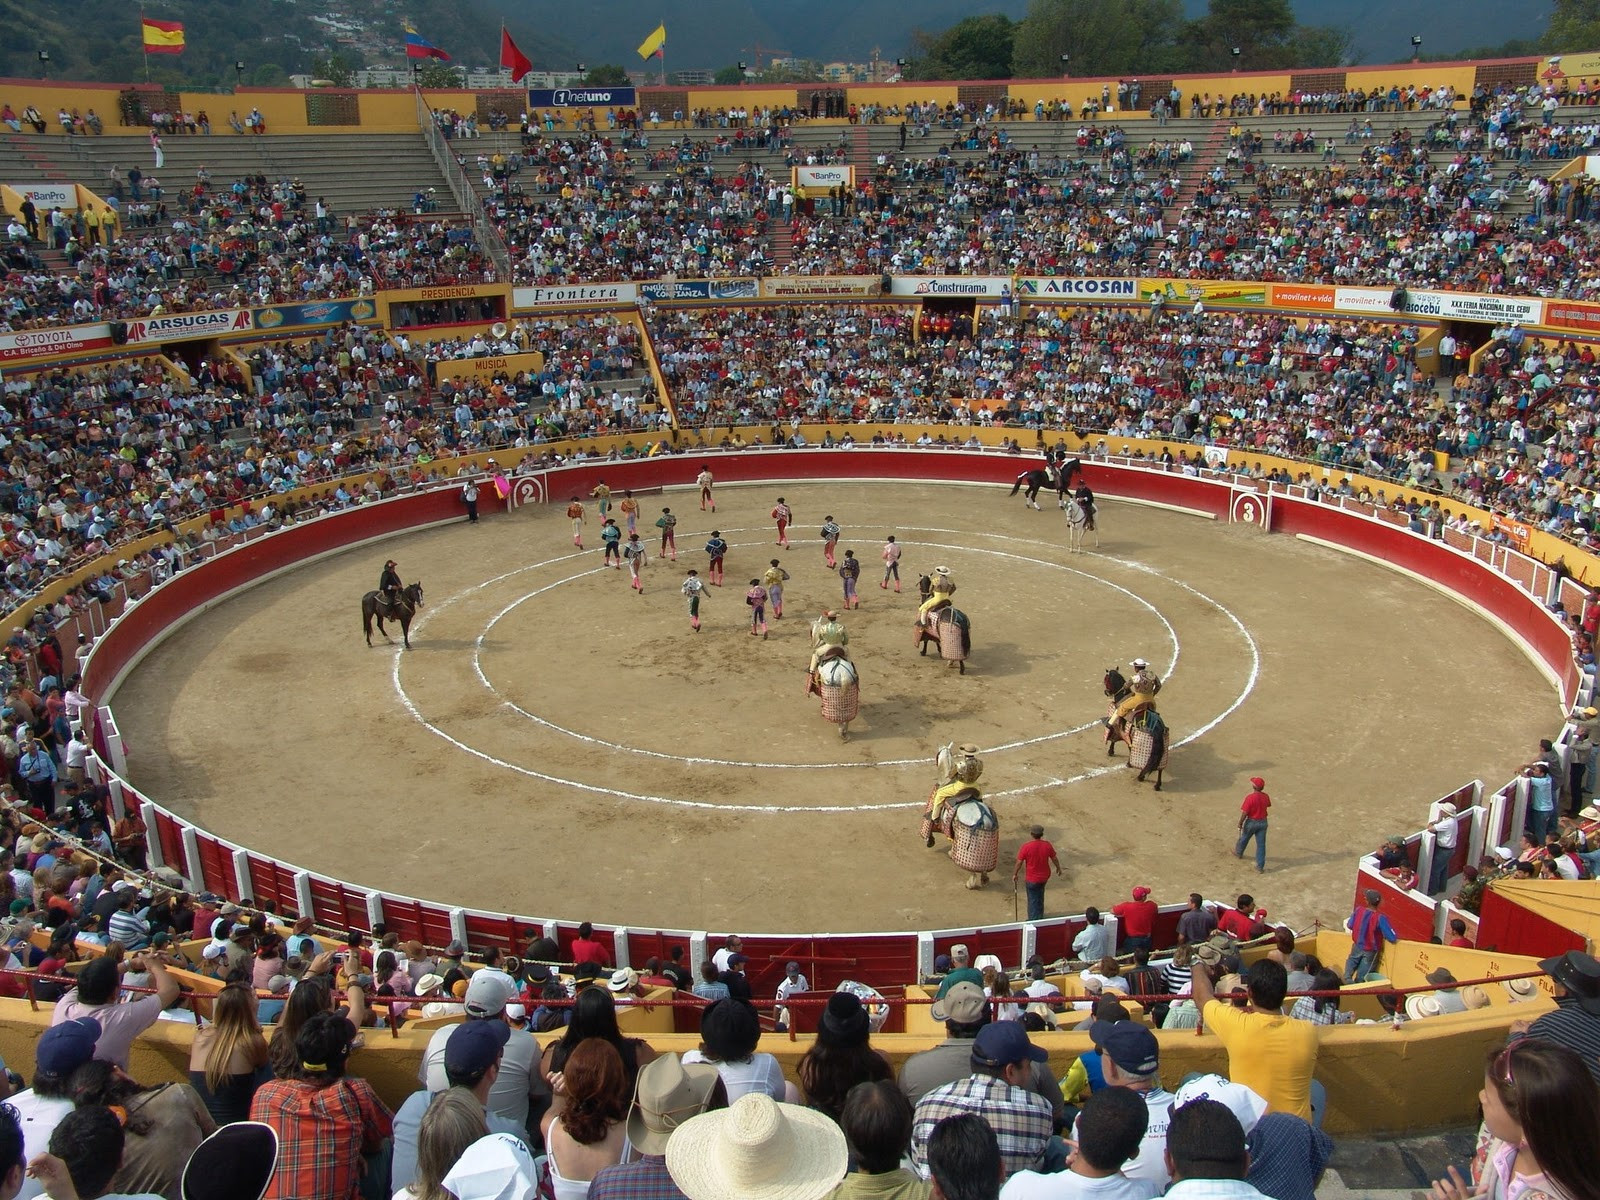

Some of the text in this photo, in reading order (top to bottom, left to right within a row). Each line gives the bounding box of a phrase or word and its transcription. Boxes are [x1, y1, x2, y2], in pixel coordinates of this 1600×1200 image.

[559, 91, 611, 103] 1 netuno
[33, 191, 66, 200] BanPro
[932, 282, 987, 294] Construrama
[1044, 280, 1134, 293] ARCOSAN
[421, 287, 476, 299] PRESIDENCIA
[534, 288, 618, 300] Frontera
[1282, 293, 1311, 302] movilnet
[1344, 296, 1376, 305] movilnet
[1479, 303, 1505, 311] NACIONAL
[148, 313, 230, 330] ARSUGAS
[31, 331, 73, 344] TOYOTA
[3, 349, 19, 357] C.A.
[20, 346, 46, 355] Briceño
[475, 359, 508, 371] MUSICA
[521, 484, 536, 504] 2
[1243, 502, 1254, 522] 3
[1538, 978, 1554, 995] FILA
